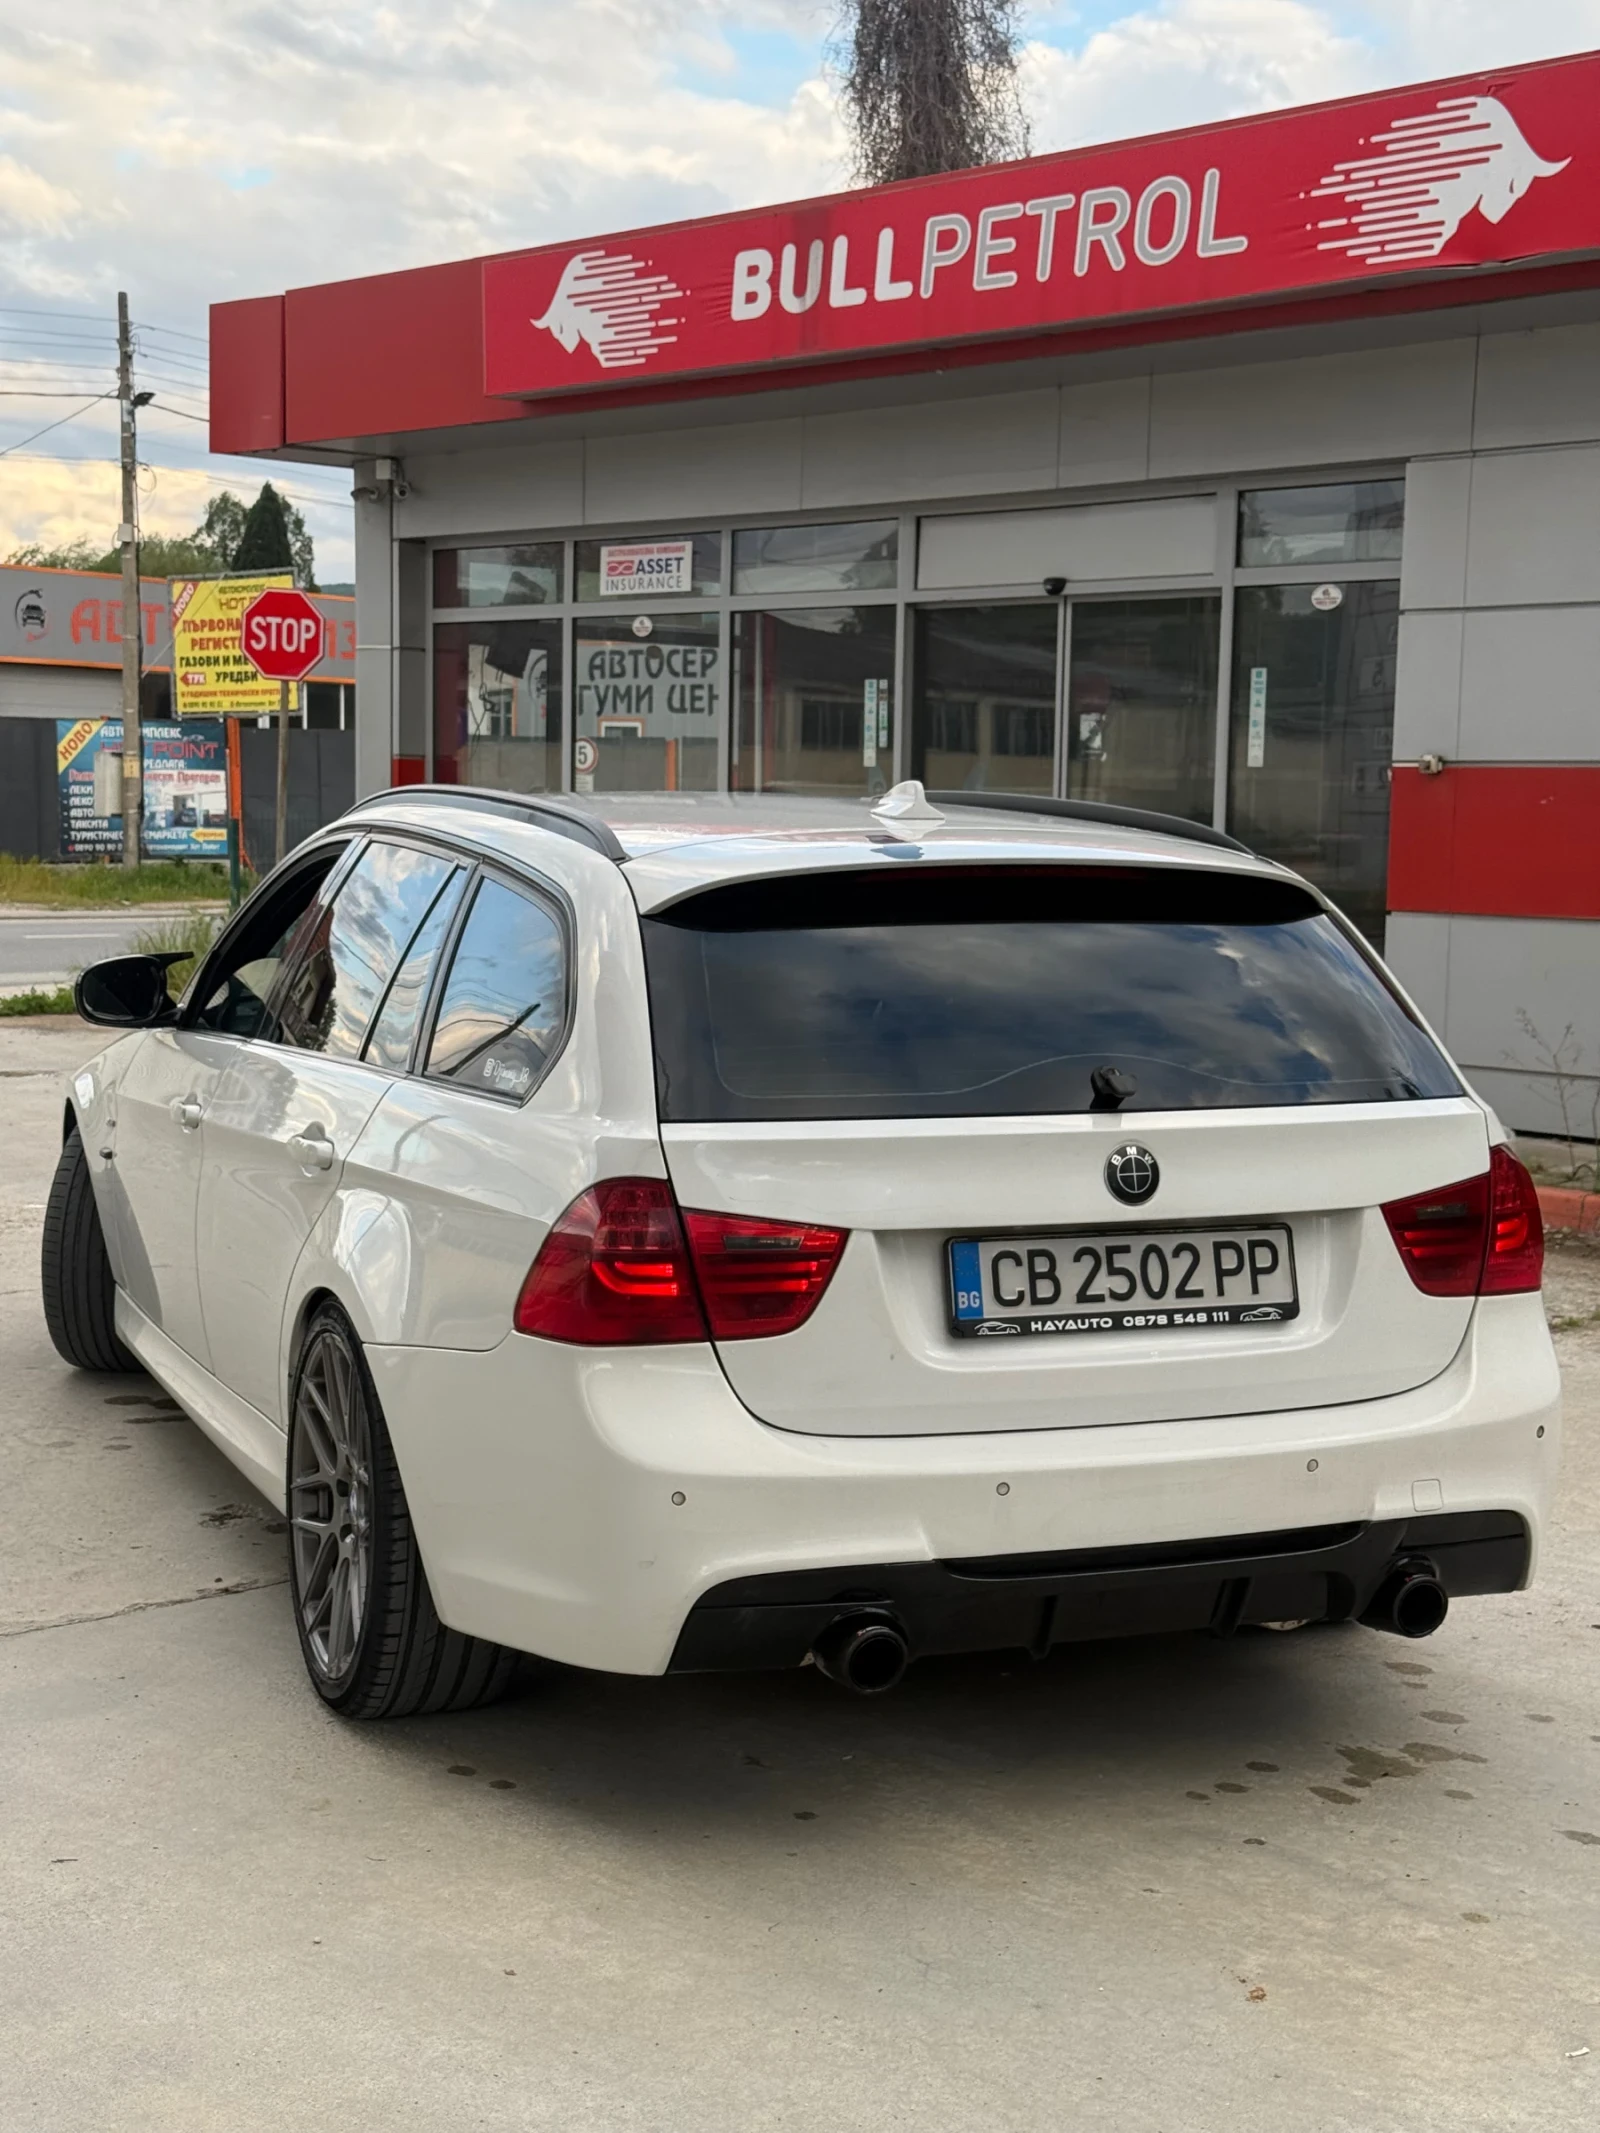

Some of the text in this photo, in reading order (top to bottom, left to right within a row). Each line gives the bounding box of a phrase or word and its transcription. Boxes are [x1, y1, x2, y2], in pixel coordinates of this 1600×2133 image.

[731, 167, 1248, 322] BULLPETROL
[635, 556, 685, 575] ASSET
[605, 575, 683, 592] INSURANCE
[174, 582, 195, 617] НОВО
[250, 616, 316, 653] STOP
[191, 637, 242, 651] РЕГИСТ
[179, 655, 220, 668] ГАЗОВИ
[222, 655, 231, 667] И
[215, 670, 259, 684] УРЕДБИ
[578, 684, 654, 717] ГУМИ
[59, 721, 94, 761] НОВО
[152, 741, 218, 759] POINT
[143, 759, 187, 769] РЕДЛАГА:
[577, 745, 588, 765] 5
[69, 797, 94, 806] ЛЕКО
[69, 809, 95, 818] АВТО
[69, 831, 124, 841] ТУРИСТИЧЕС
[991, 1239, 1280, 1307] CB 2502 PP
[957, 1291, 980, 1308] BG
[1030, 1310, 1230, 1332] HAYAUTO 0878 548 111
